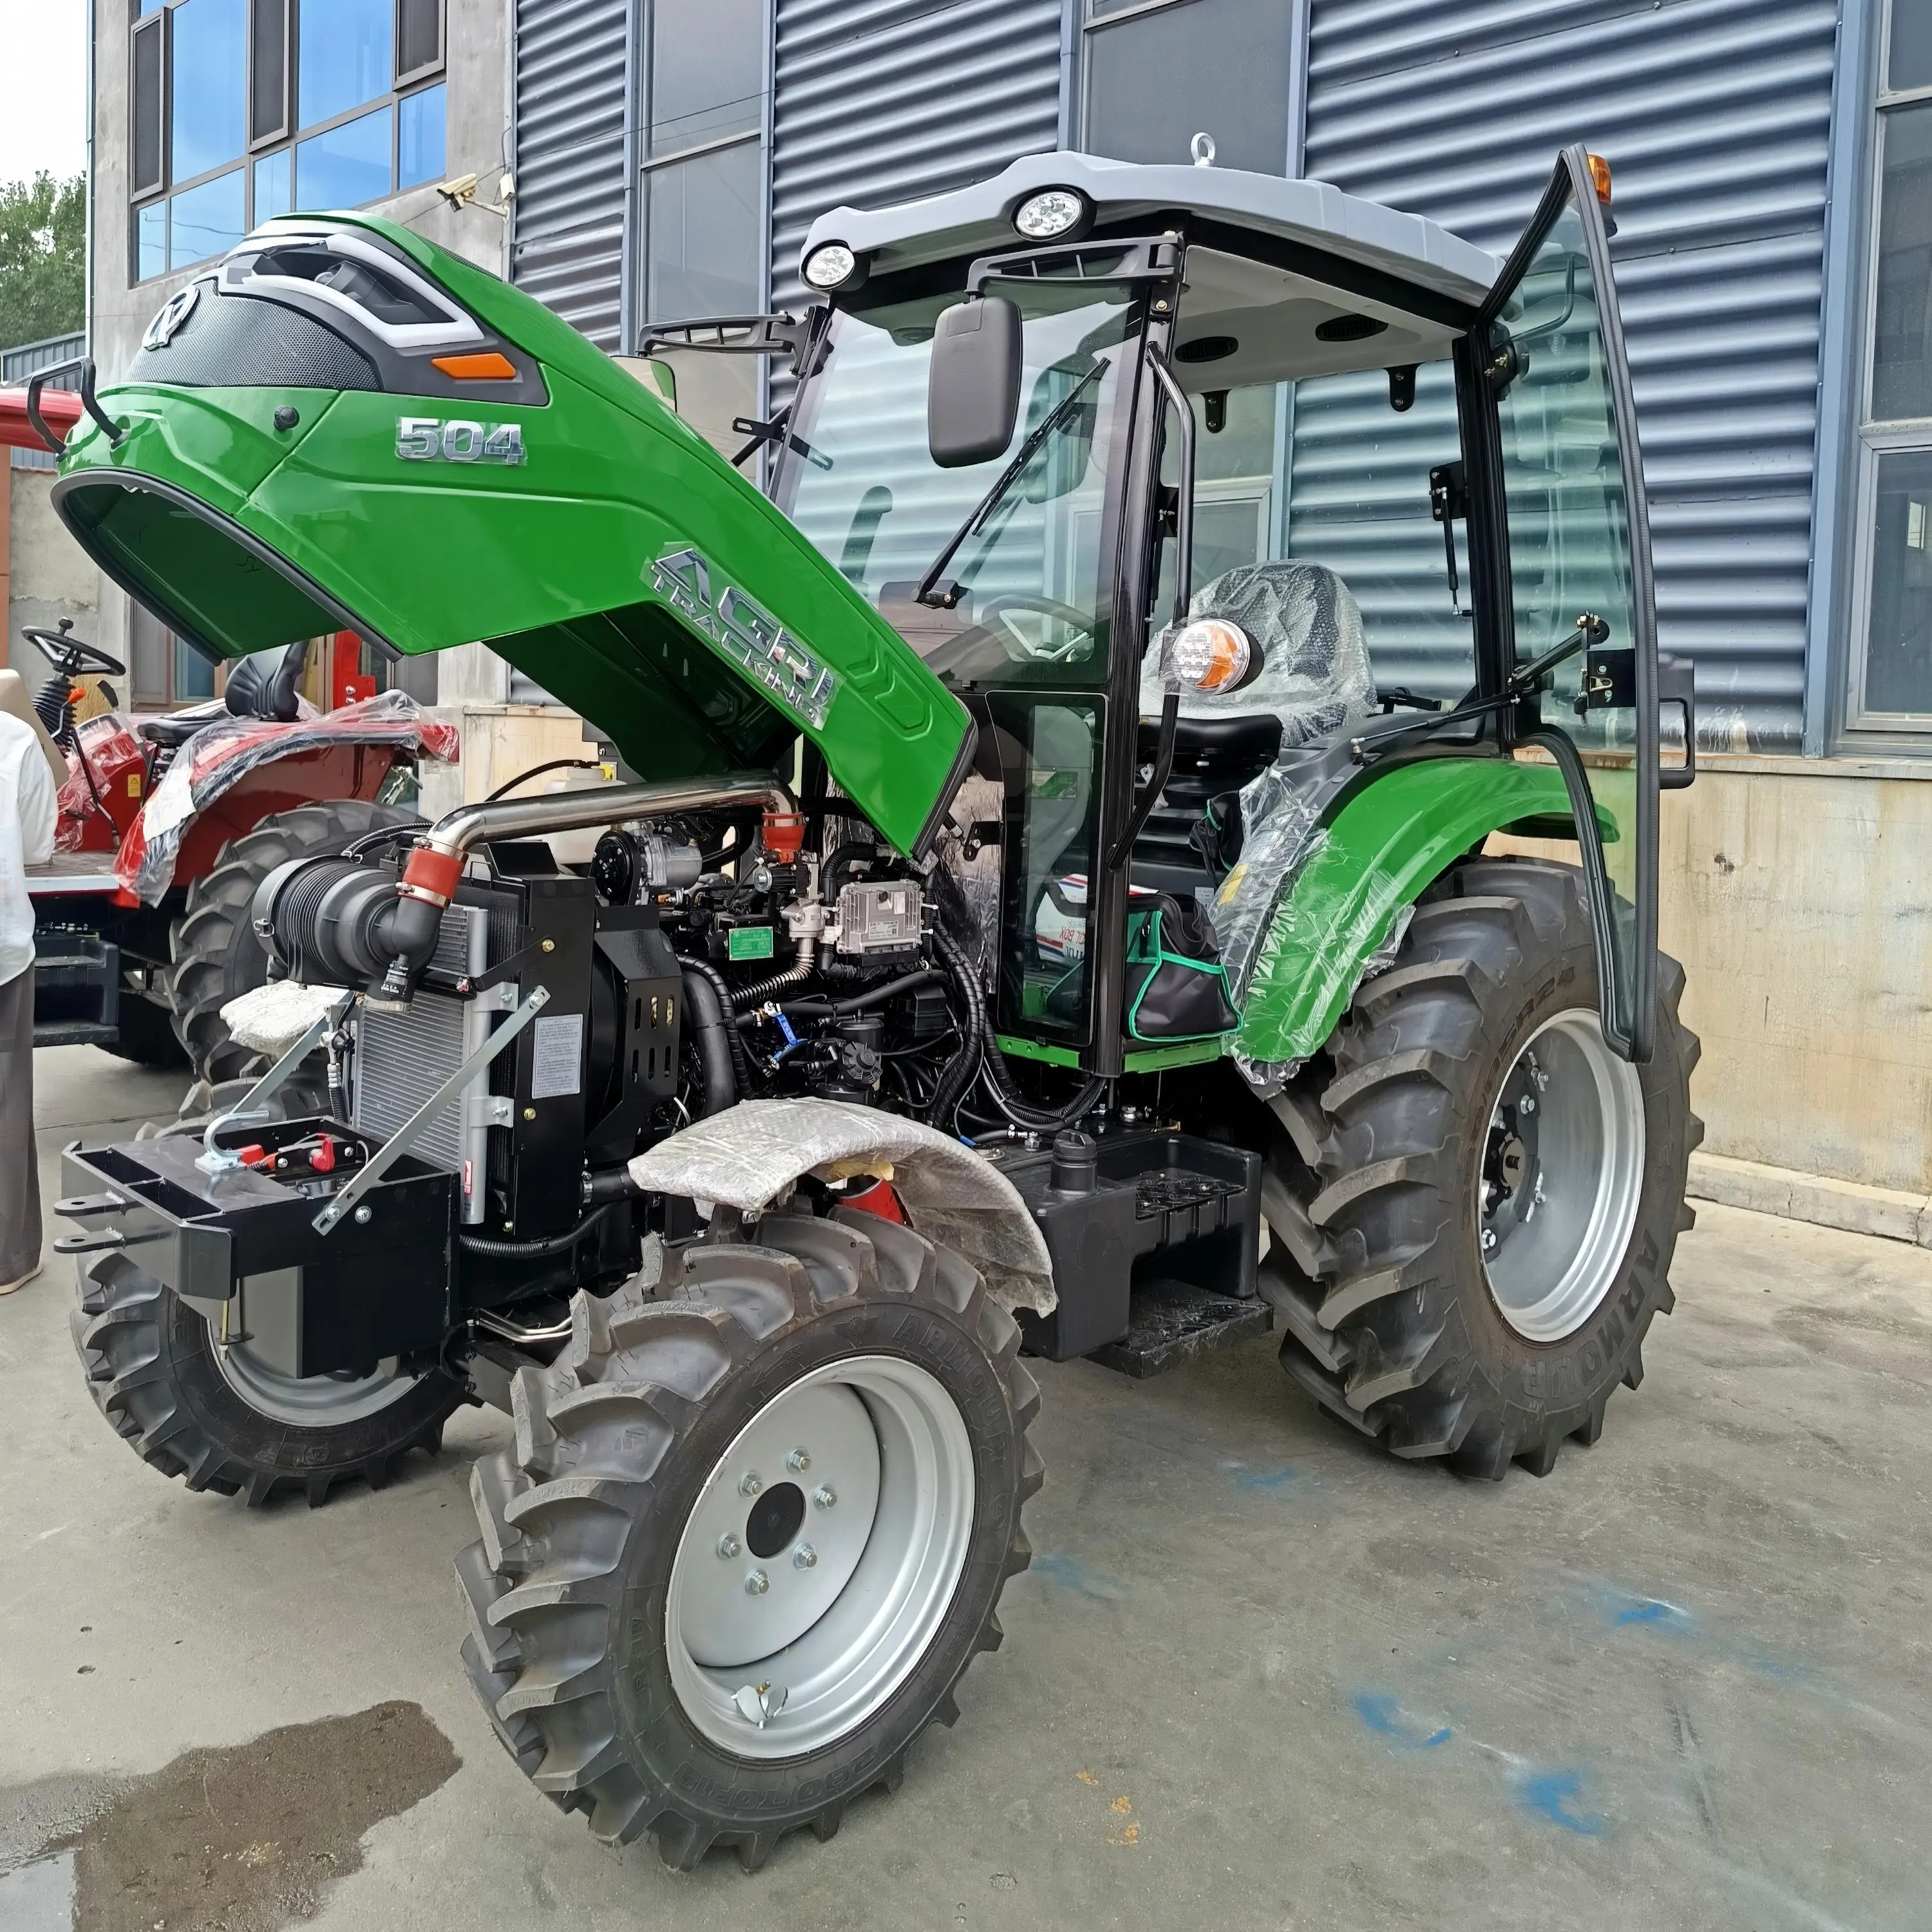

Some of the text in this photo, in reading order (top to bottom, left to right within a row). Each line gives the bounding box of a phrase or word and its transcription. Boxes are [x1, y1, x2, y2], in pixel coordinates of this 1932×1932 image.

[399, 417, 524, 464] 504
[650, 565, 819, 724] TRACKING
[654, 547, 835, 702] AGRI
[891, 1313, 1010, 1464] ARMOUR
[1520, 1227, 1660, 1399] ARMOUR
